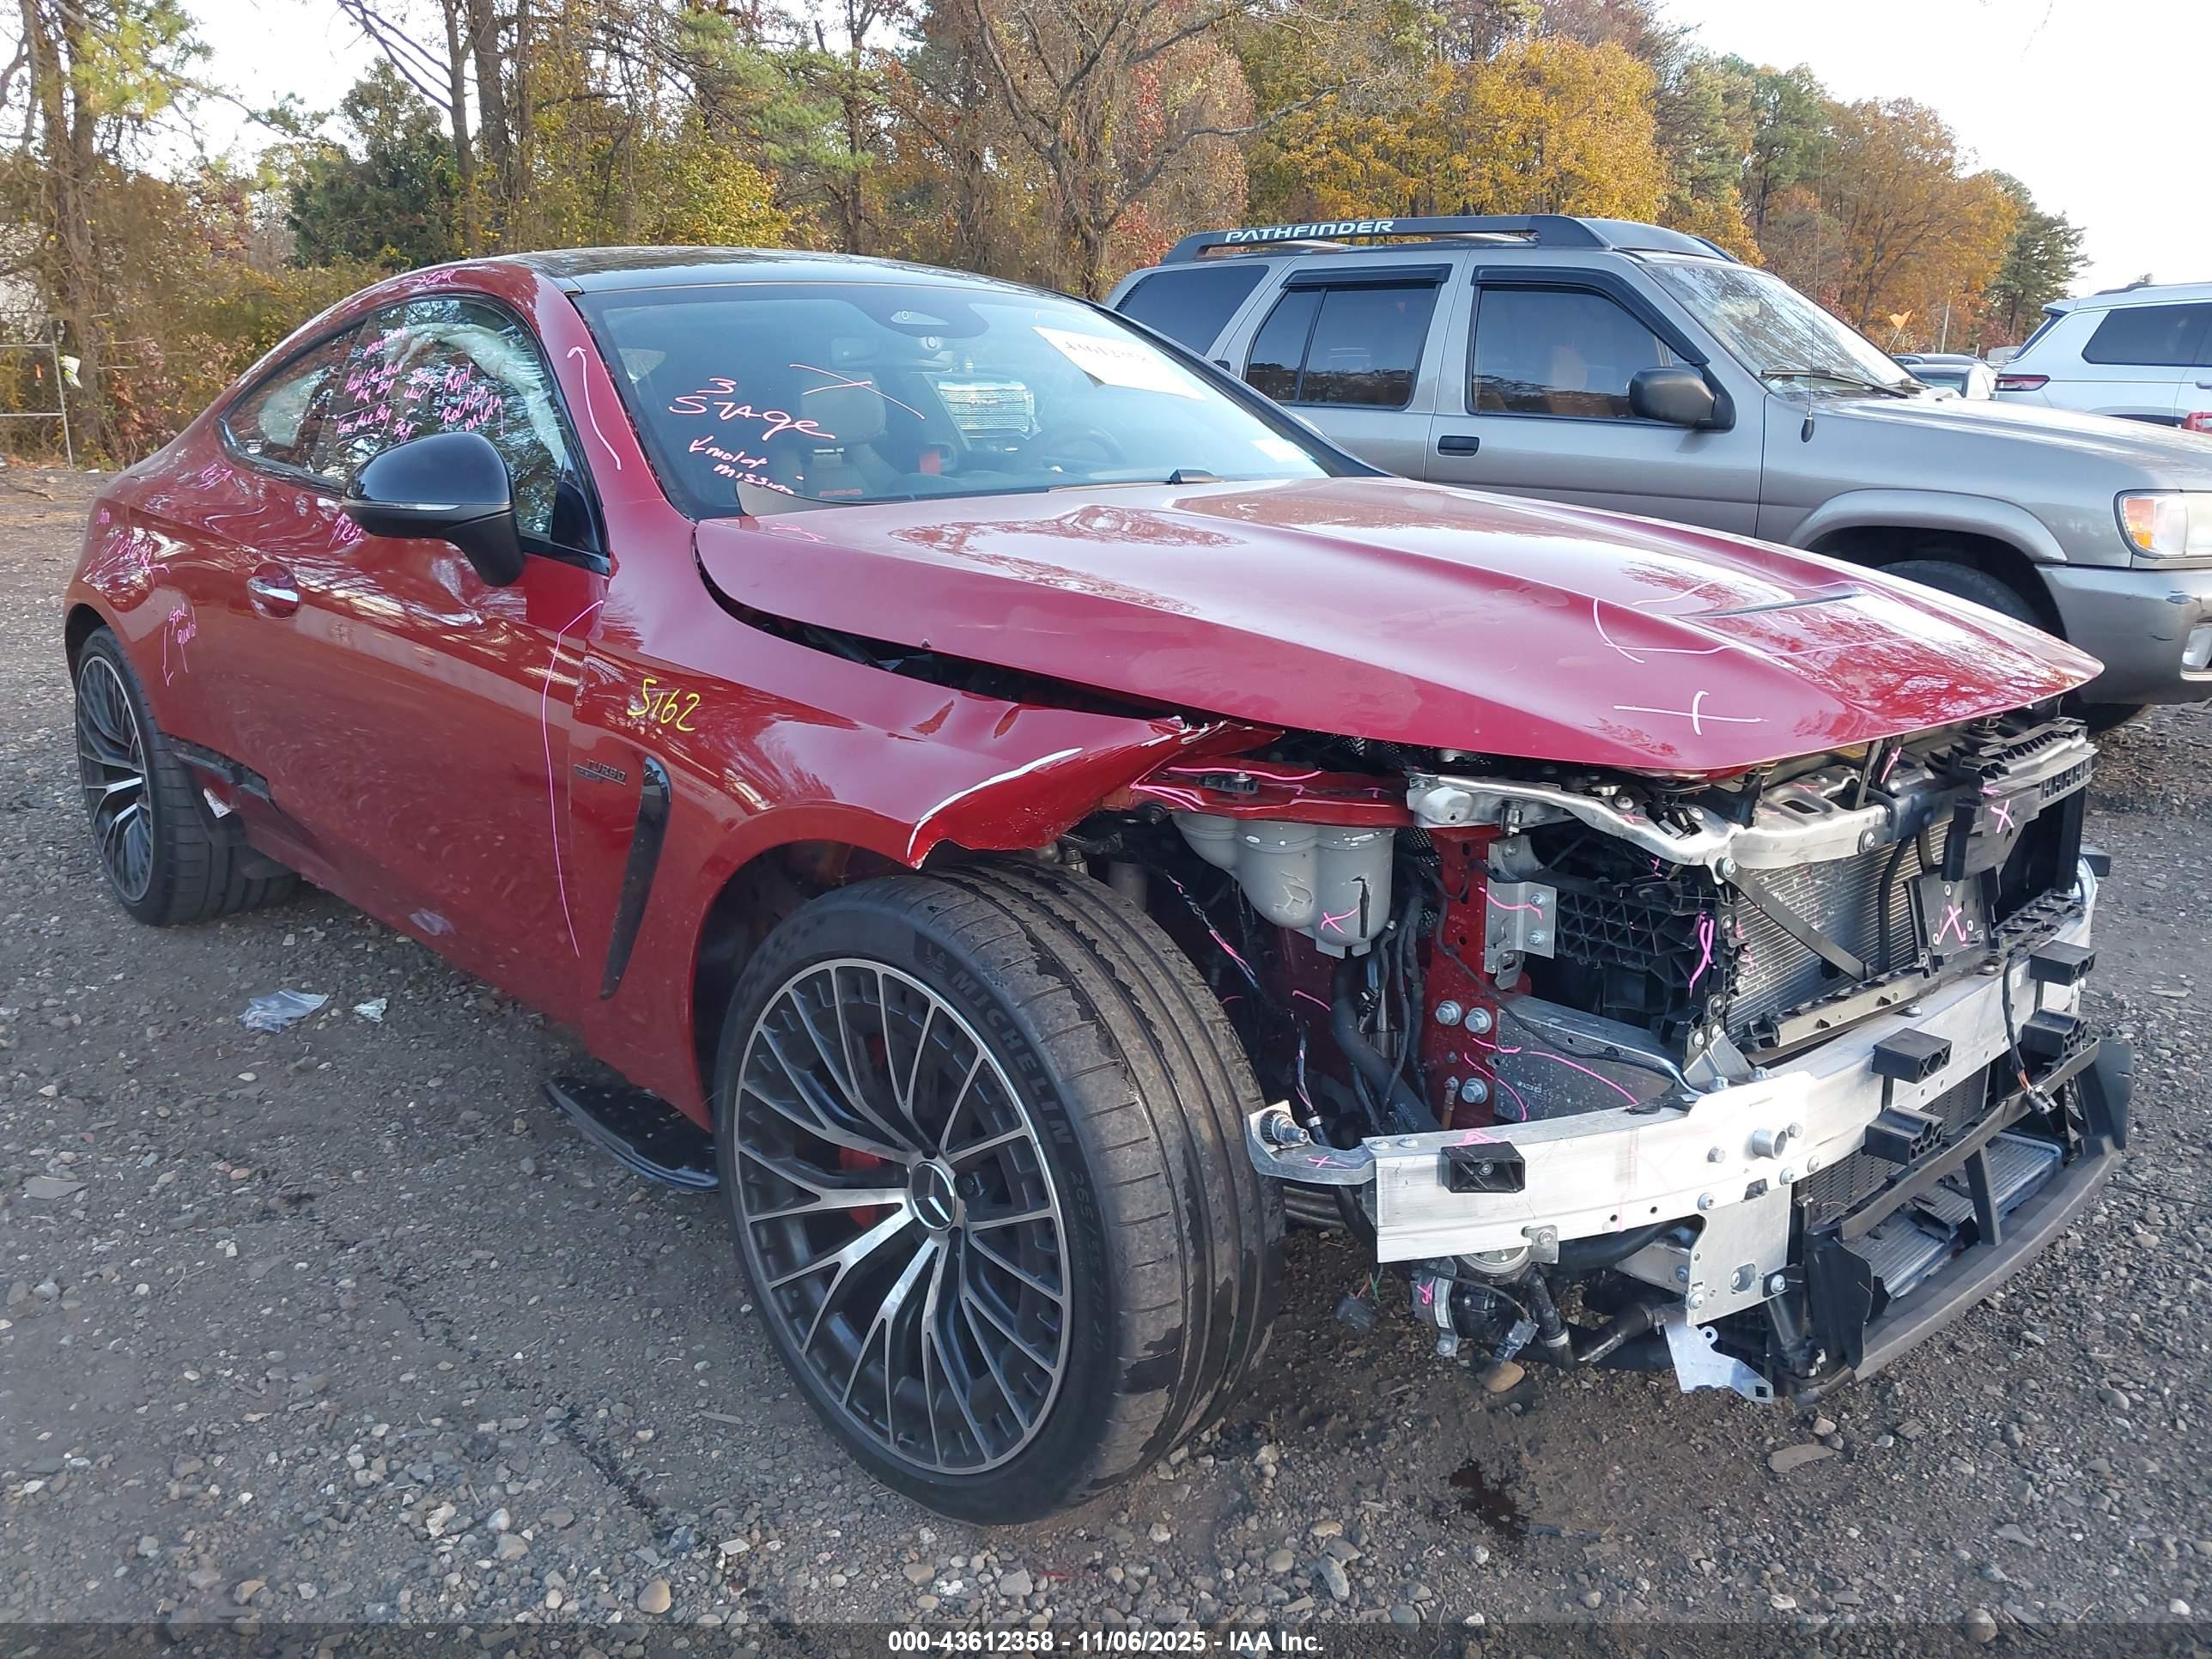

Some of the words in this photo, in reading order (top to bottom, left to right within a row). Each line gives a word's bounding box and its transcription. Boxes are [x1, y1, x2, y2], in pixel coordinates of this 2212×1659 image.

[1224, 220, 1395, 243] PATHFINDER
[627, 677, 701, 732] 5162
[586, 757, 626, 782] TURBO
[951, 969, 1075, 1146] MICHELIN
